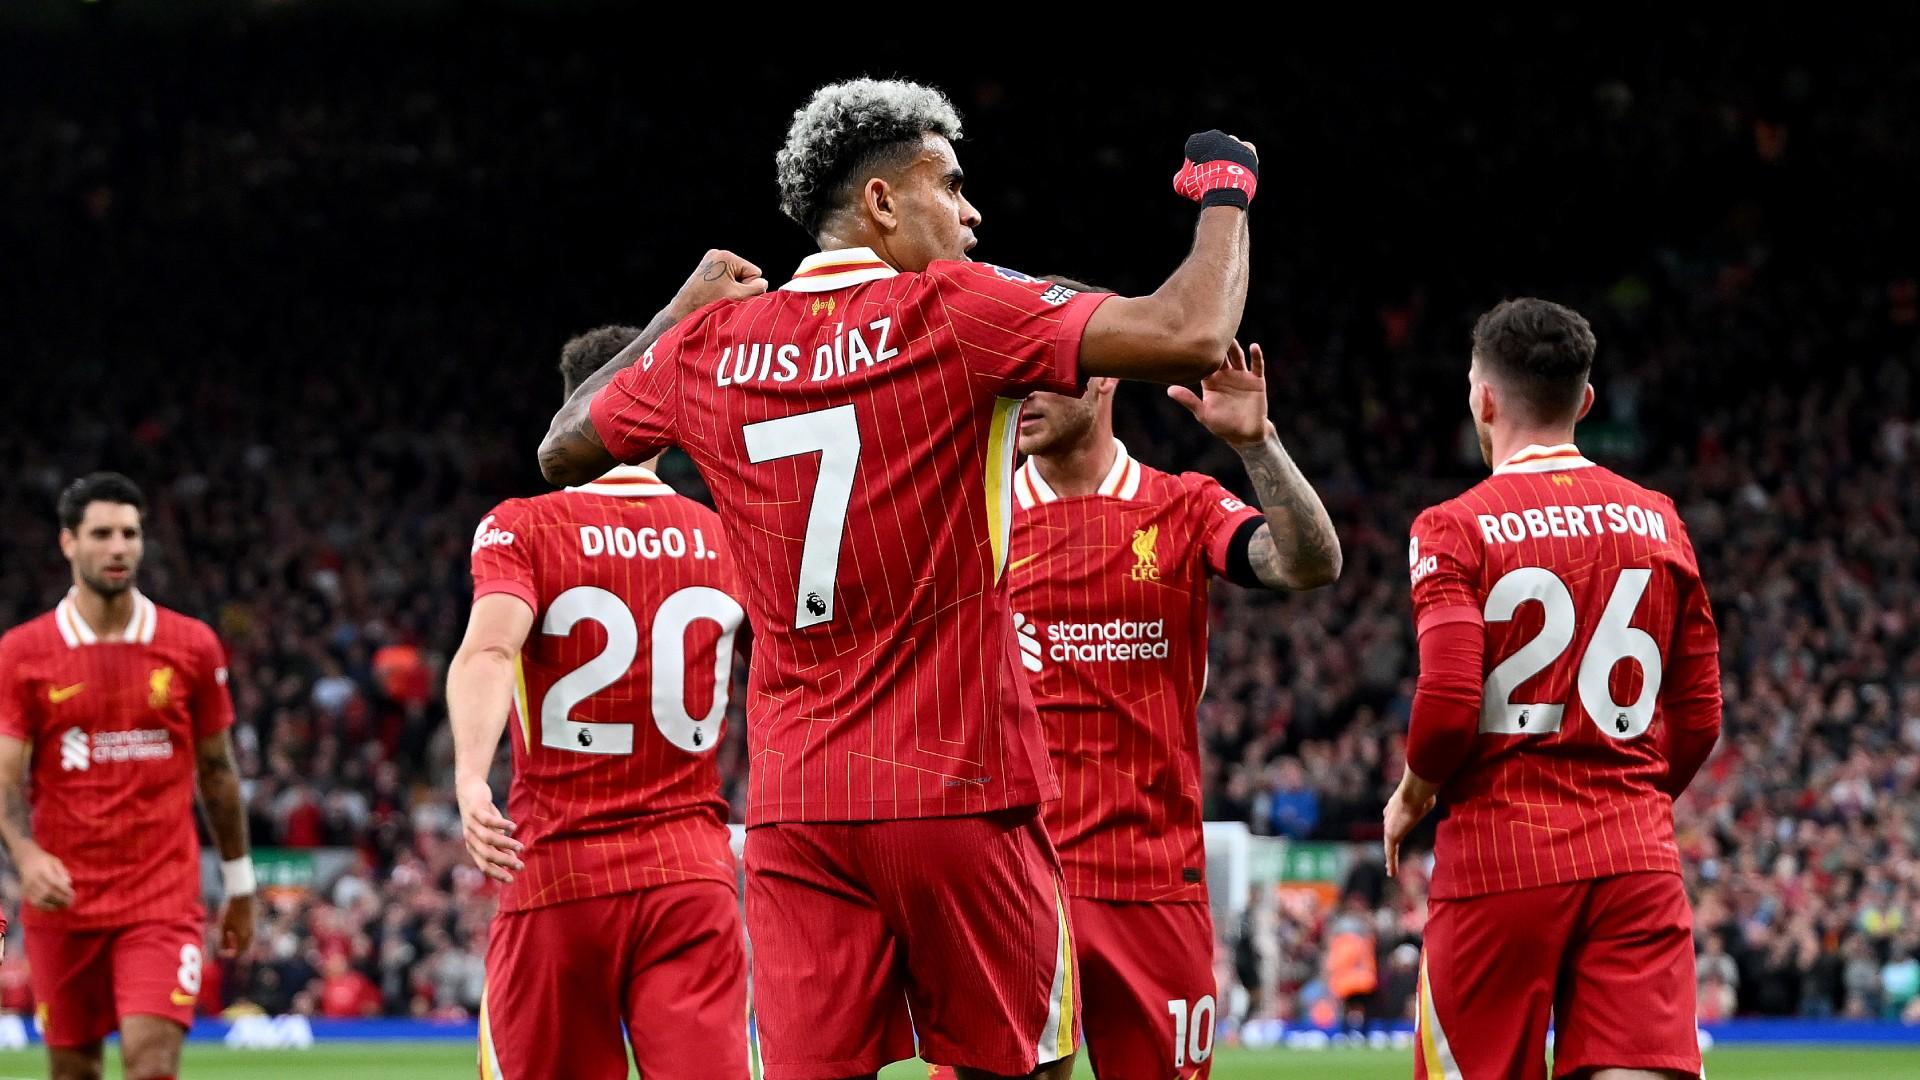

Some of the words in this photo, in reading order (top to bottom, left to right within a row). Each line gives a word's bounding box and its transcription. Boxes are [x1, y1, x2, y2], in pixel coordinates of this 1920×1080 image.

[717, 343, 801, 387] LUIS
[811, 316, 899, 382] DÍAZ
[579, 525, 686, 560] DIOGO
[693, 528, 717, 560] J.
[742, 403, 862, 630] 7
[1477, 501, 1668, 544] ROBERTSON
[1131, 567, 1161, 582] LFC
[1047, 618, 1164, 641] standard
[1049, 638, 1169, 663] chartered
[1478, 566, 1663, 740] 26
[541, 585, 745, 754] 20
[177, 943, 202, 995] 8
[1167, 994, 1216, 1068] 10
